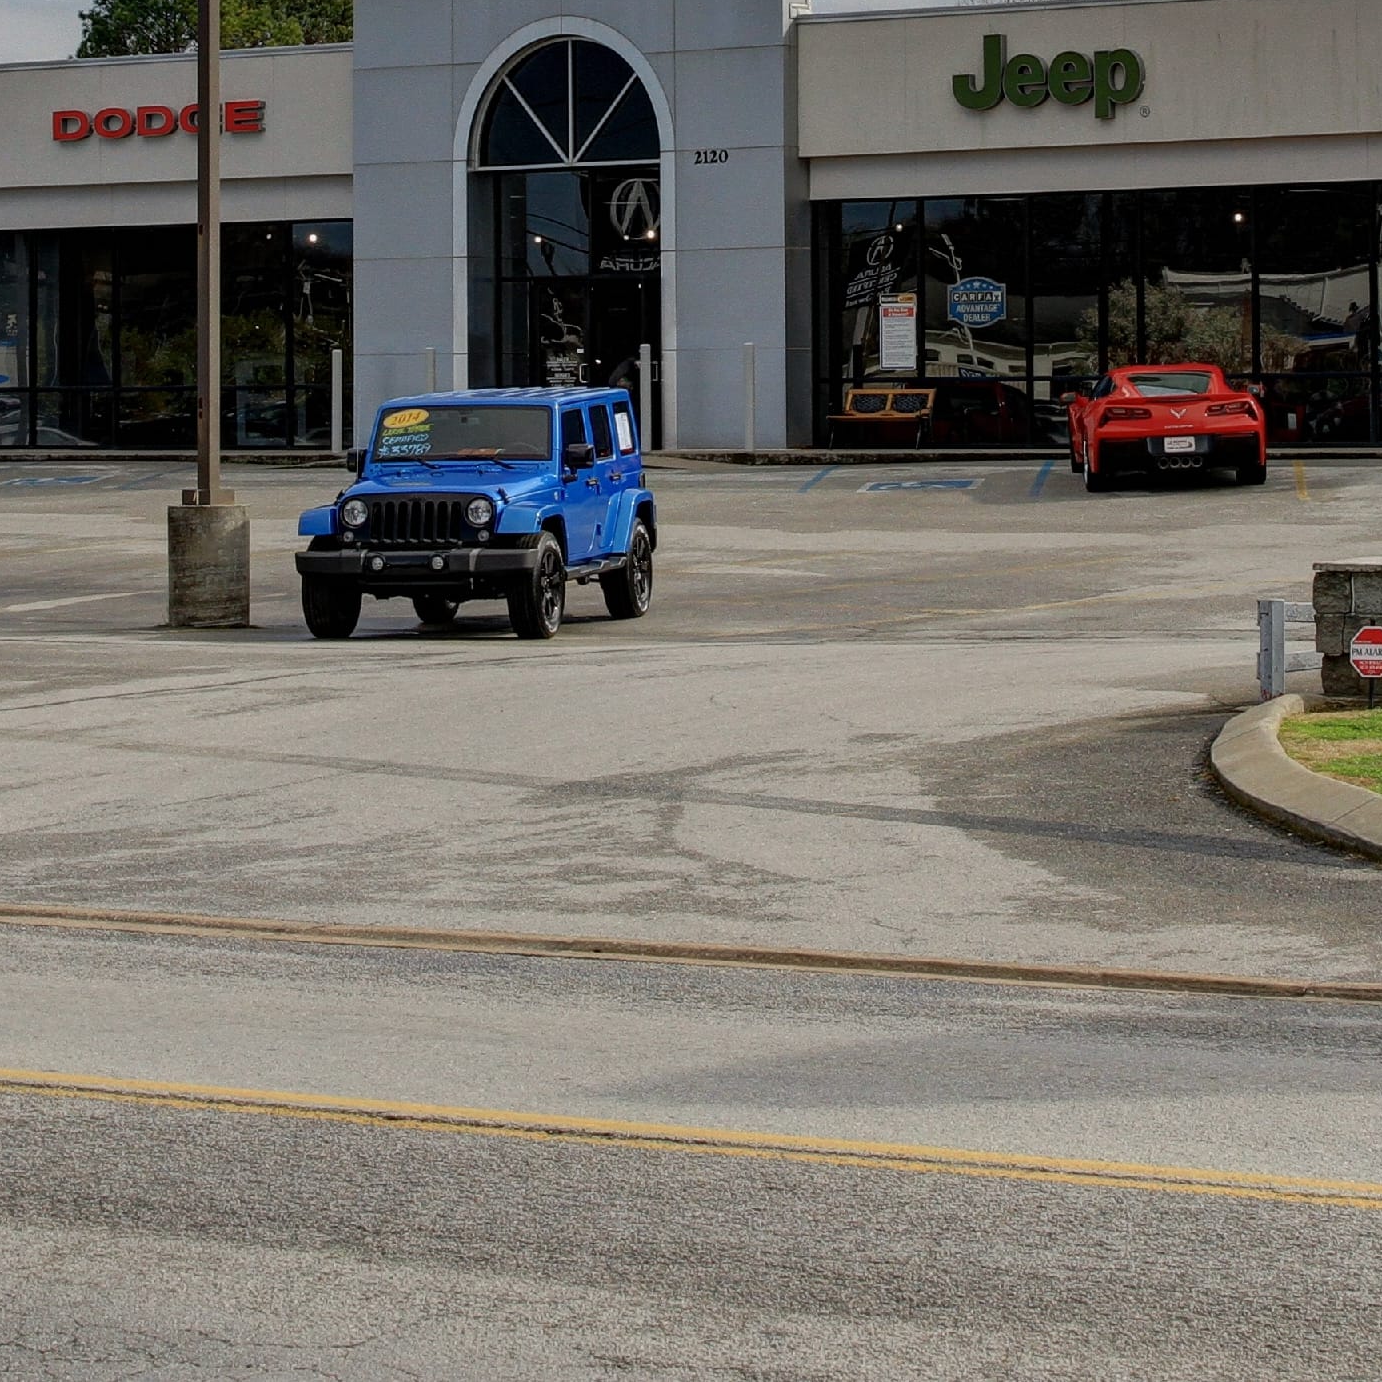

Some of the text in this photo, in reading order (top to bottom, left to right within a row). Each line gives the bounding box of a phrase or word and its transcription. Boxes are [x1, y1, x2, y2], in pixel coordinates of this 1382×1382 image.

[952, 34, 1146, 119] Jeep
[694, 149, 729, 165] 2120
[953, 292, 1001, 302] CARFAX
[956, 304, 1000, 313] ADVANTAGE
[963, 314, 991, 322] DEALER
